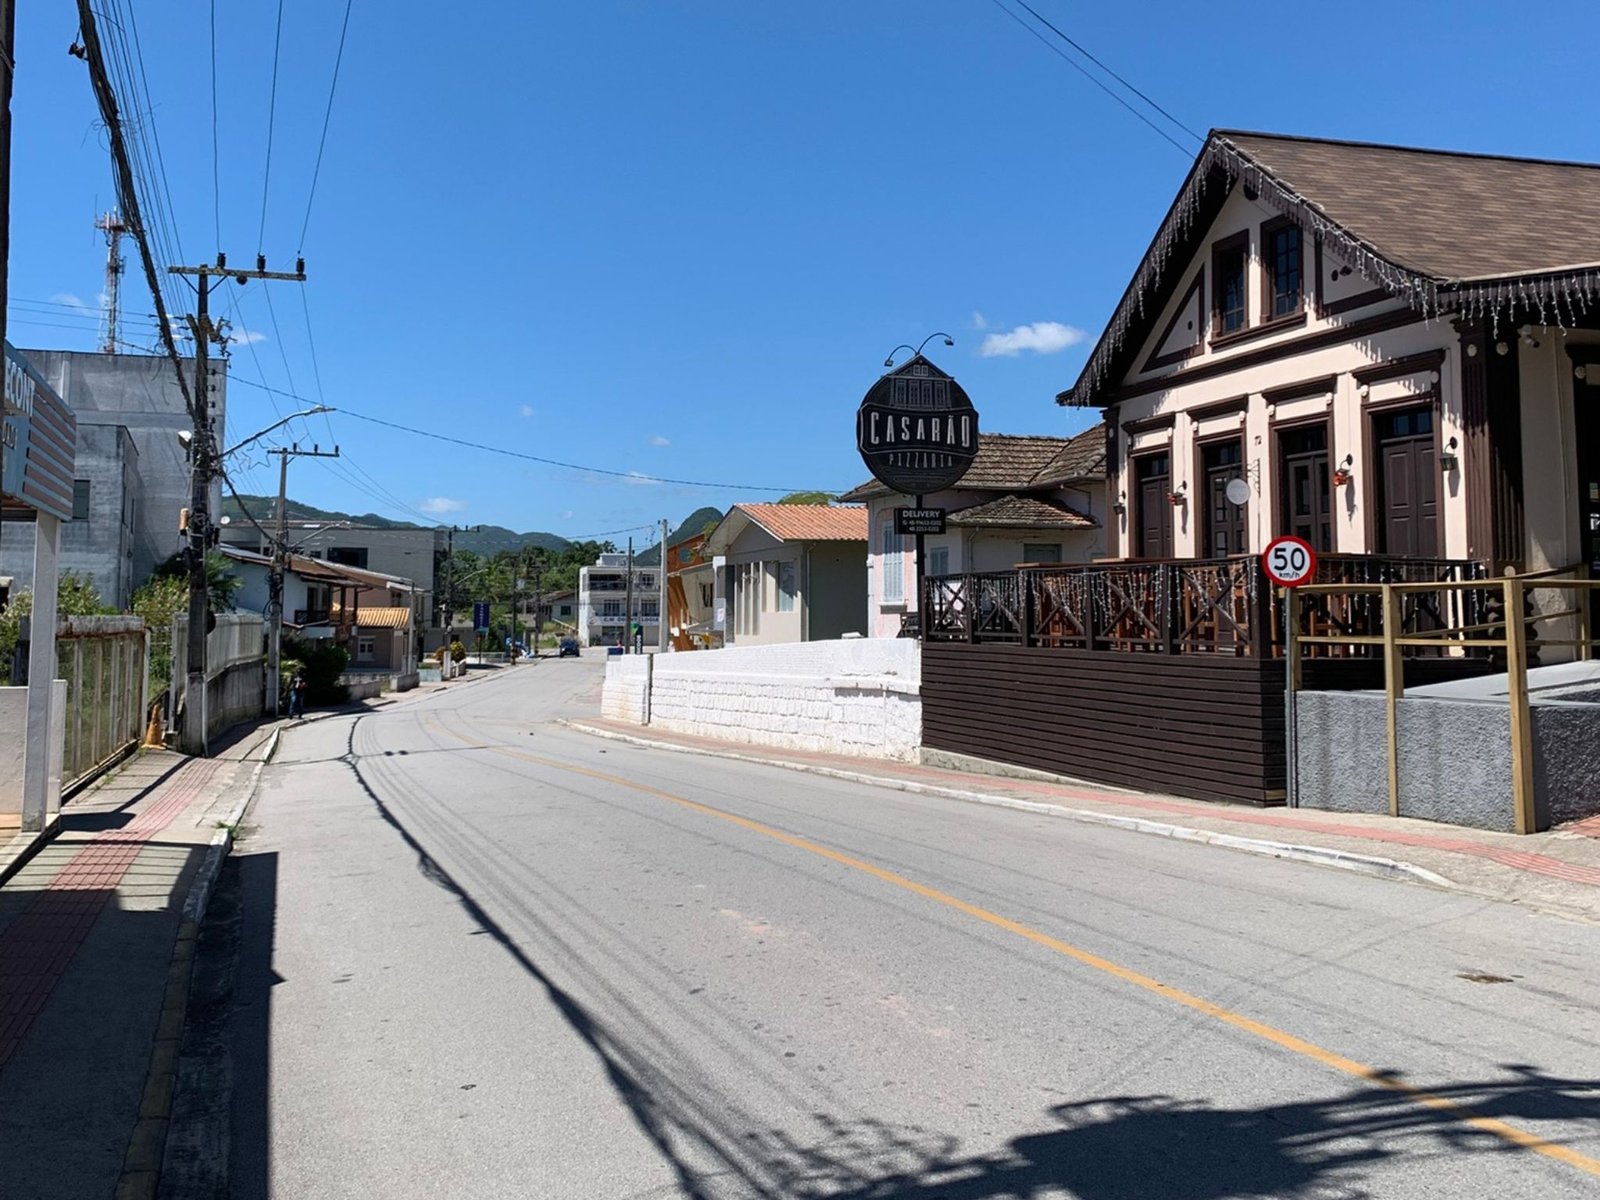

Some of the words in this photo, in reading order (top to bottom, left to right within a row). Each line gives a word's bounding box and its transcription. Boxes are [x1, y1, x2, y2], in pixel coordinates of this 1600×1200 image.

[870, 411, 970, 448] CASARÃO
[888, 451, 953, 469] PIZZARIA
[902, 510, 941, 518] DELIVERY
[1273, 546, 1306, 572] 50
[1278, 570, 1301, 579] km/h
